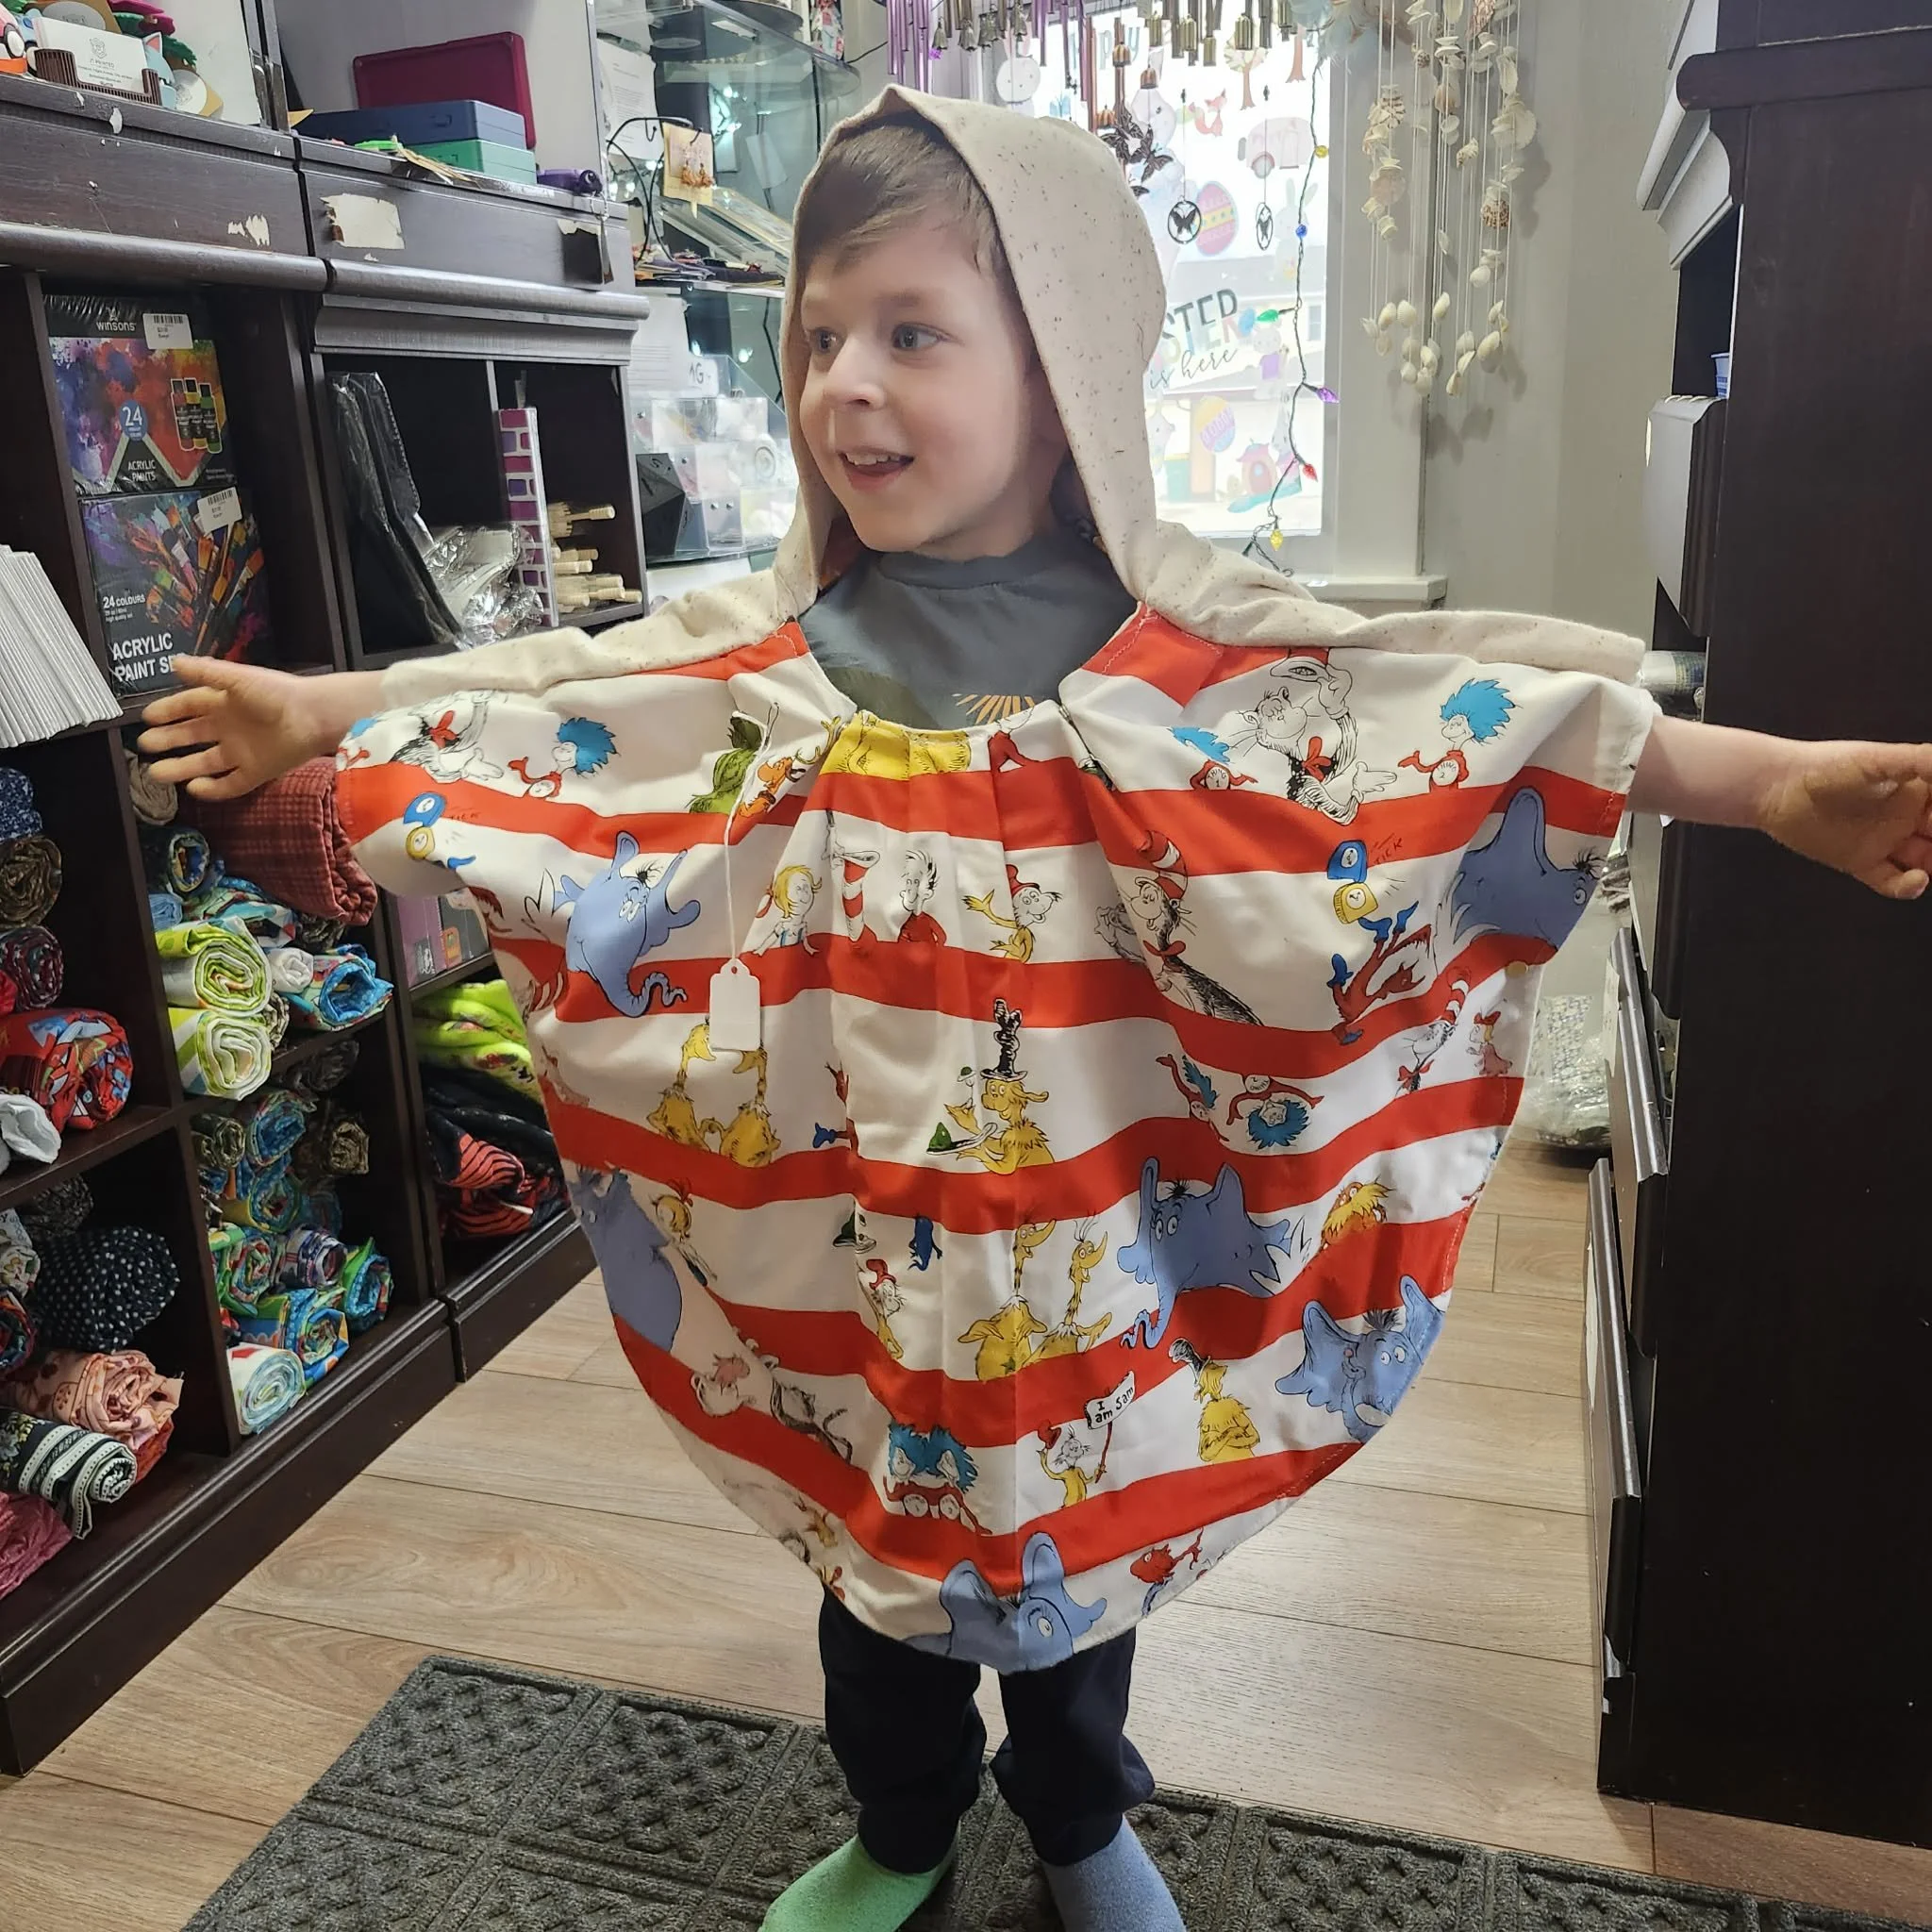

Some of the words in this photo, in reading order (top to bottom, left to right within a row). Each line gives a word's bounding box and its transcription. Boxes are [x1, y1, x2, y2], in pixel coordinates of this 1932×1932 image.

[1181, 349, 1239, 379] here
[123, 406, 142, 426] 24
[128, 460, 156, 471] ACRYLIC
[103, 595, 115, 608] 24
[116, 594, 145, 607] COLOURS
[113, 633, 174, 660] ACRYLIC
[114, 659, 156, 682] PAINT
[1208, 769, 1226, 779] THING
[1215, 779, 1220, 788] 1
[1374, 838, 1403, 865] TICK
[1094, 1409, 1113, 1424] am
[1115, 1387, 1133, 1410] Sam
[1096, 1400, 1105, 1411] I
